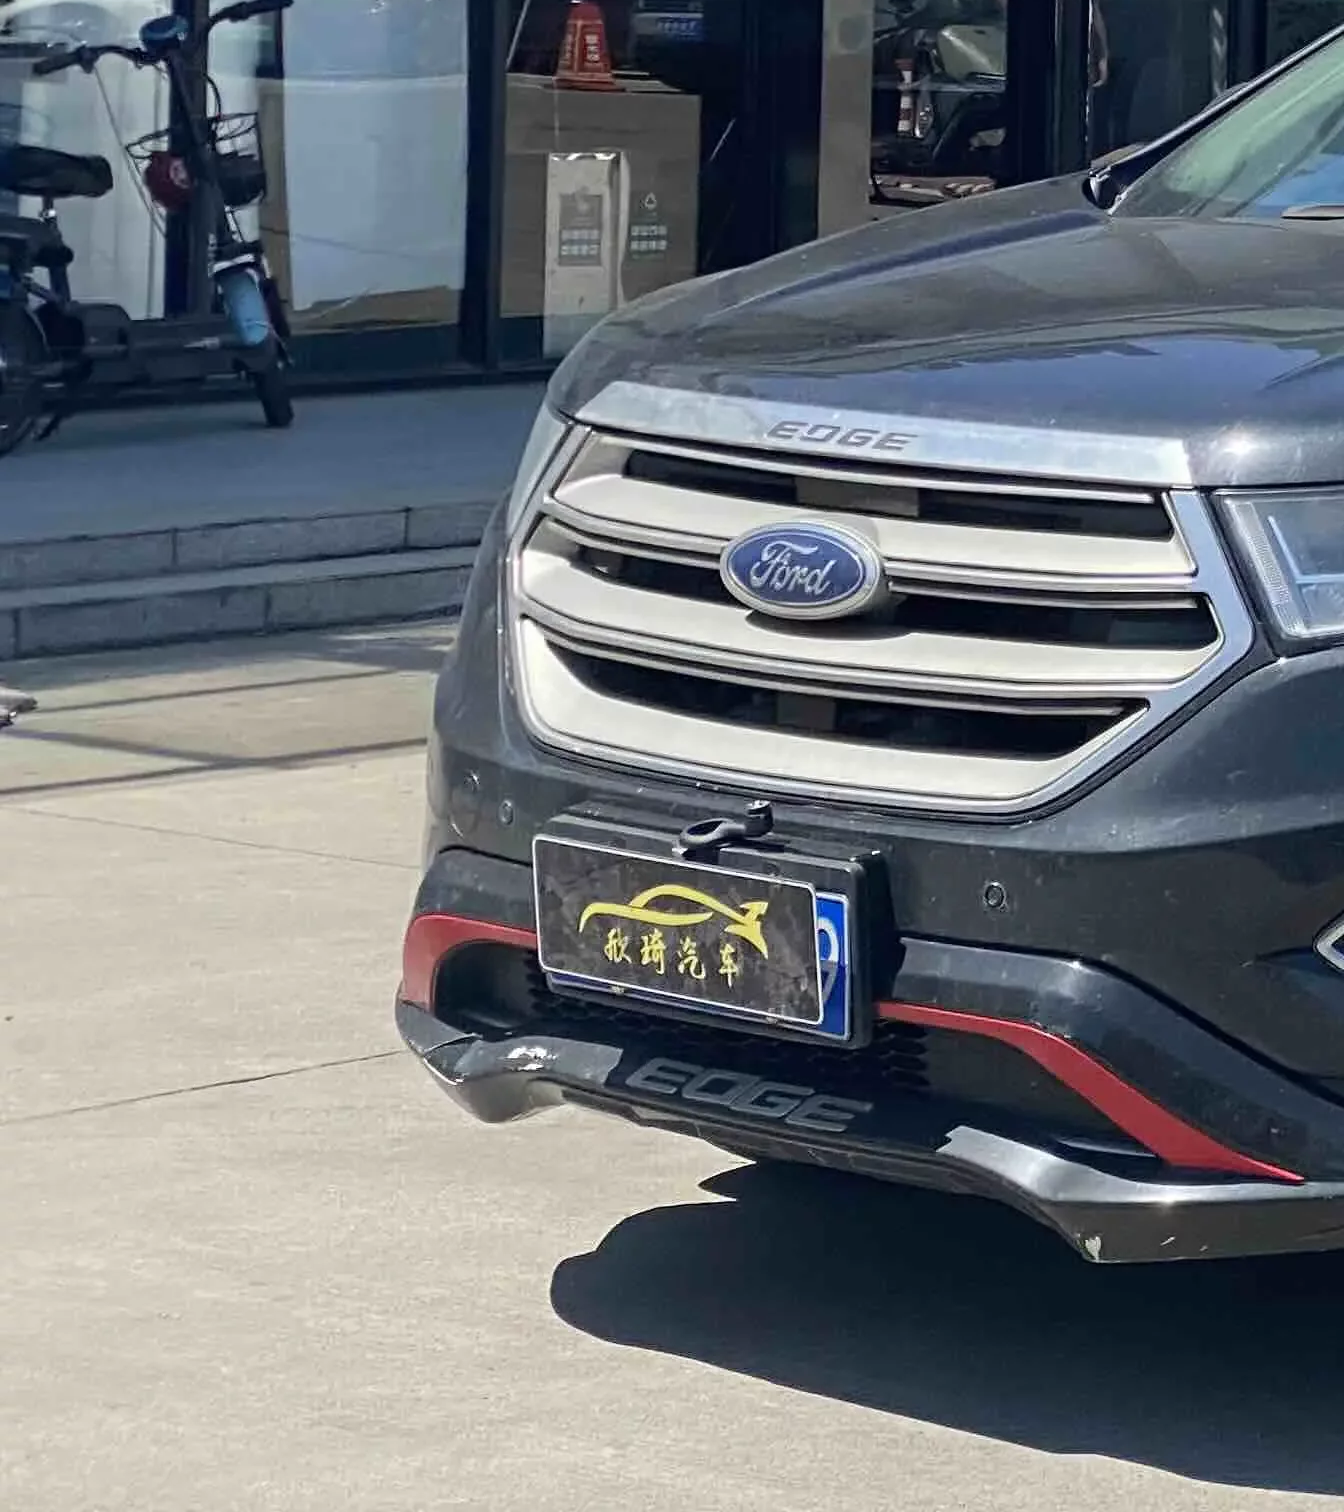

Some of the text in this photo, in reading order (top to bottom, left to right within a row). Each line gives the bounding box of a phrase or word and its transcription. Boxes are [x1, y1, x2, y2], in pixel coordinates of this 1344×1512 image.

[766, 419, 919, 452] EDGE
[750, 539, 839, 596] Ford
[603, 927, 740, 988] 欣琦汽车
[625, 1056, 873, 1133] EDGE
